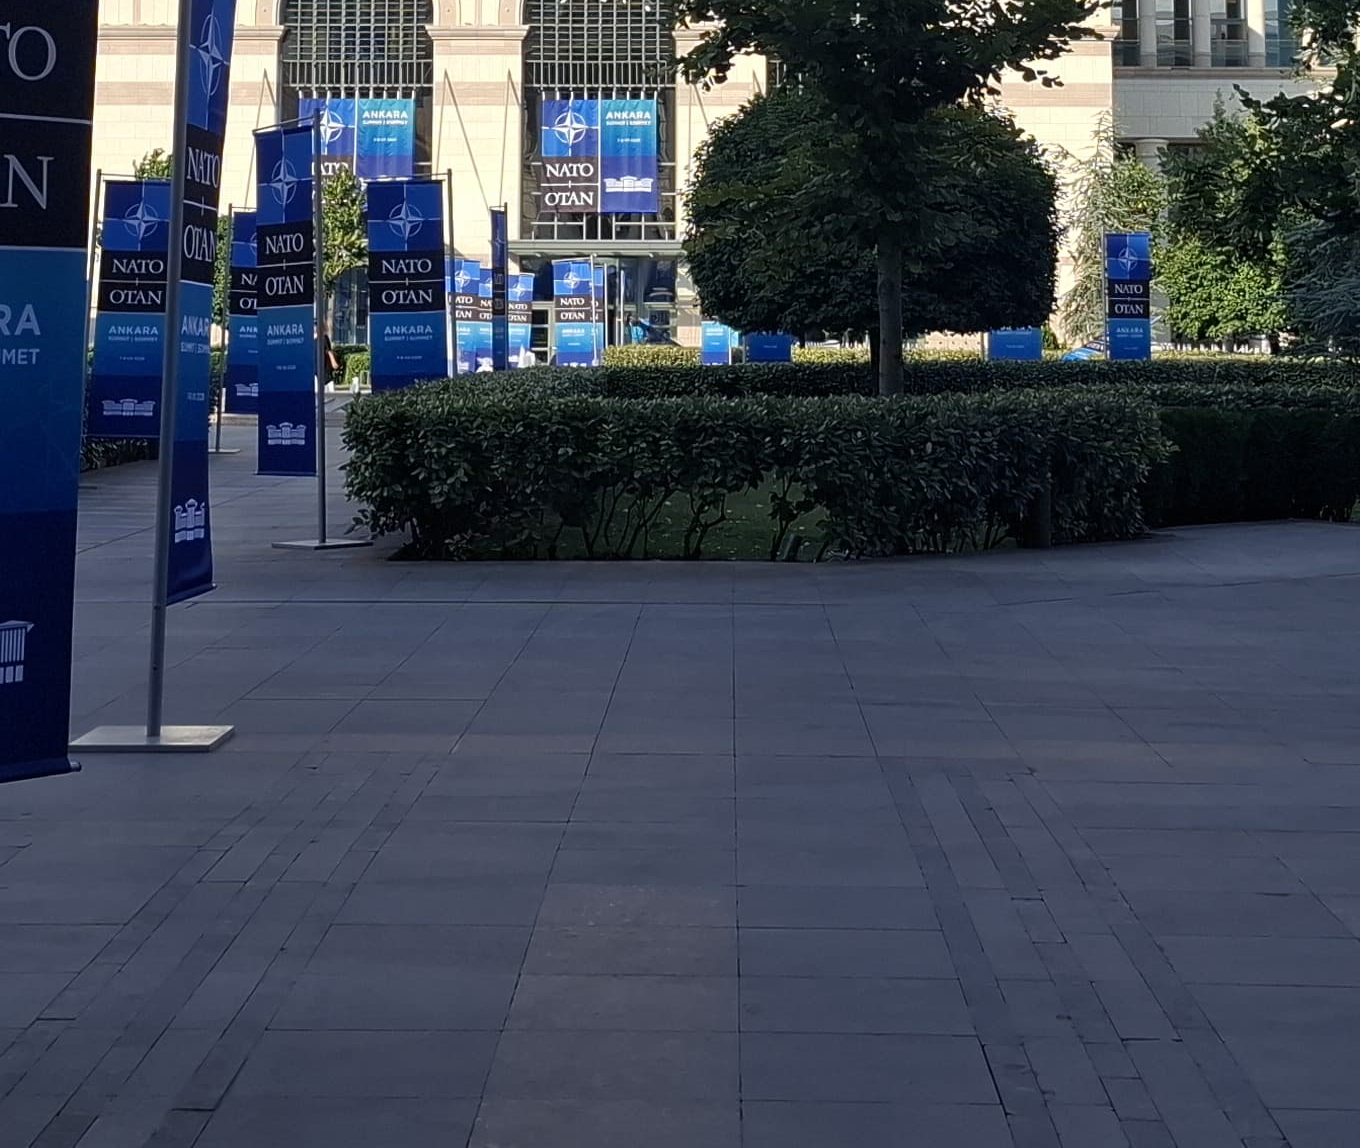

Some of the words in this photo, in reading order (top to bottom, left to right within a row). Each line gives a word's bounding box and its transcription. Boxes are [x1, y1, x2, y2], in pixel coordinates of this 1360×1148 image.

[362, 110, 408, 119] ANKARA
[606, 111, 651, 119] ANKARA
[186, 146, 221, 189] NATO
[546, 163, 594, 177] NATO
[544, 192, 594, 206] OTAN
[266, 233, 304, 254] NATO
[112, 259, 164, 274] NATO
[382, 259, 433, 274] NATO
[265, 275, 304, 296] OTAN
[1114, 284, 1143, 294] NATO
[110, 290, 163, 305] OTAN
[382, 290, 433, 305] OTAN
[560, 297, 585, 306] NATO
[1114, 304, 1143, 314] OTAN
[560, 312, 585, 320] OTAN
[108, 325, 159, 335] ANKARA
[267, 323, 305, 336] ANKARA
[384, 325, 433, 335] ANKARA
